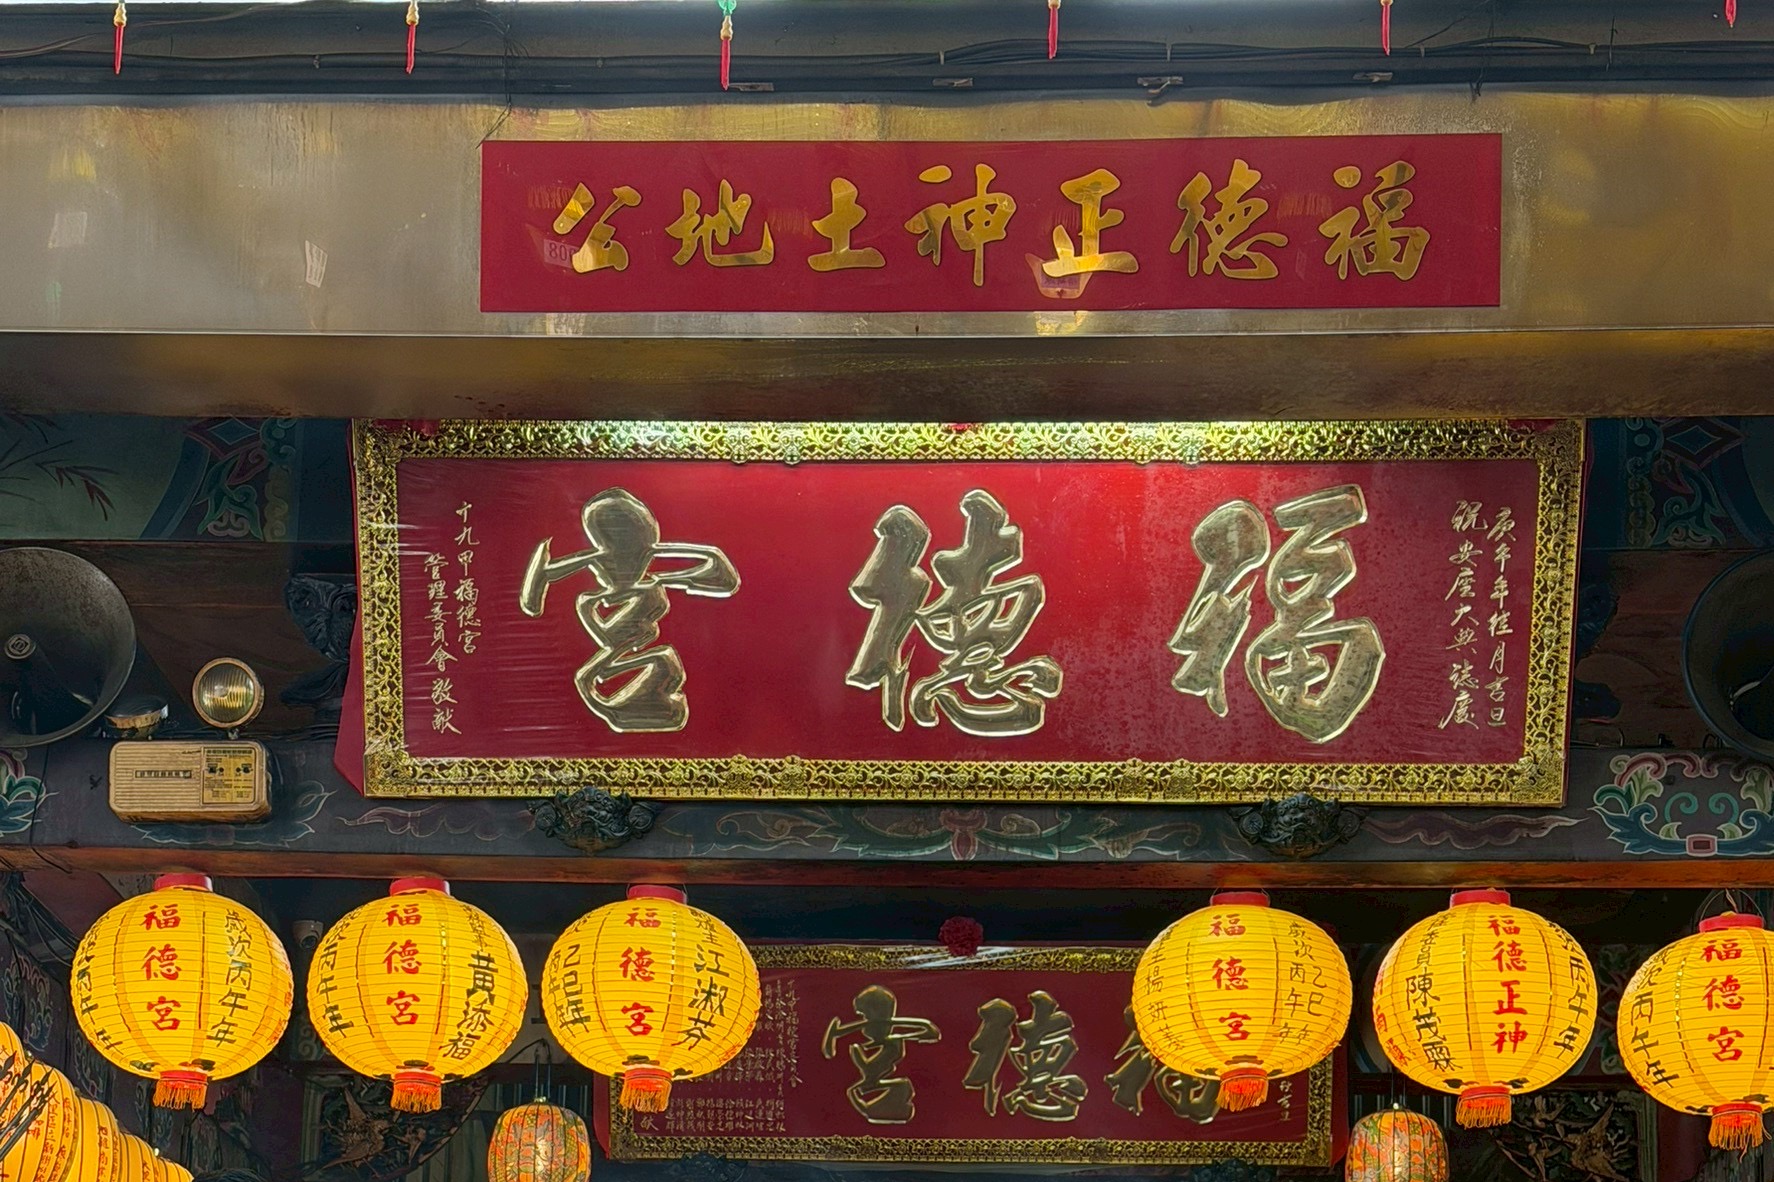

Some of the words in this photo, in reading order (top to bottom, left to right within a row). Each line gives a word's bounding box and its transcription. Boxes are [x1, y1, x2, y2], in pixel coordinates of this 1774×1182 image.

[551, 158, 1434, 286] 福德正神土地公
[519, 484, 1386, 745] 福德宮
[139, 903, 182, 1032] 福德宮
[382, 903, 423, 1026] 福德宮
[619, 907, 661, 1037] 福德宮
[1208, 913, 1254, 1042] 福德宮
[1487, 914, 1529, 1055] 福德正神
[1701, 938, 1746, 1062] 福德宮
